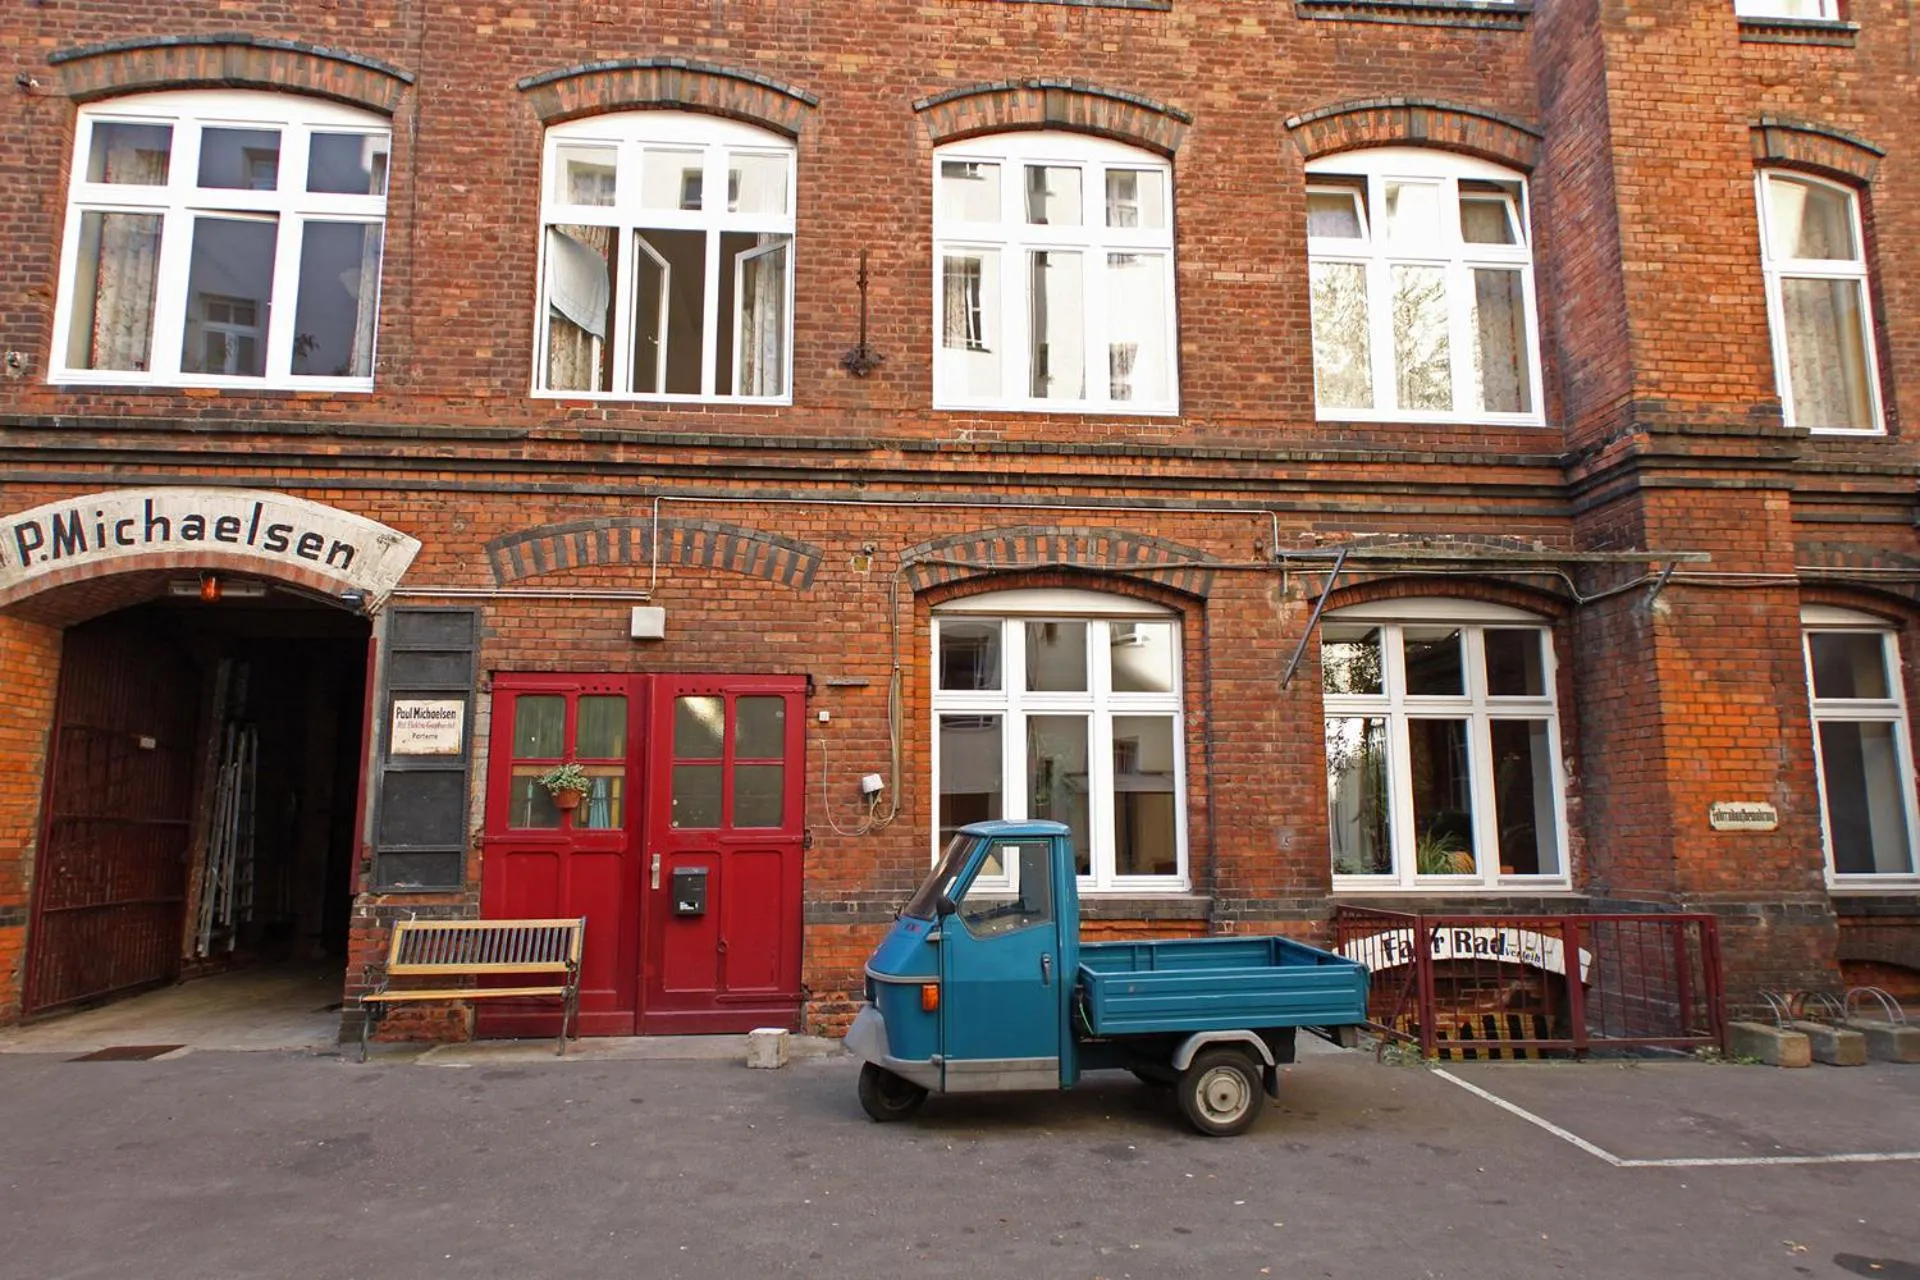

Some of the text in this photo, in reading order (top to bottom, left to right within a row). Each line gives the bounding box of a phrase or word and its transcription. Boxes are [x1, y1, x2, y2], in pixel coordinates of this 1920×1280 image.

[396, 707, 456, 719] Paul Michaelsen
[1382, 936, 1445, 962] Far
[1454, 930, 1507, 956] Rad
